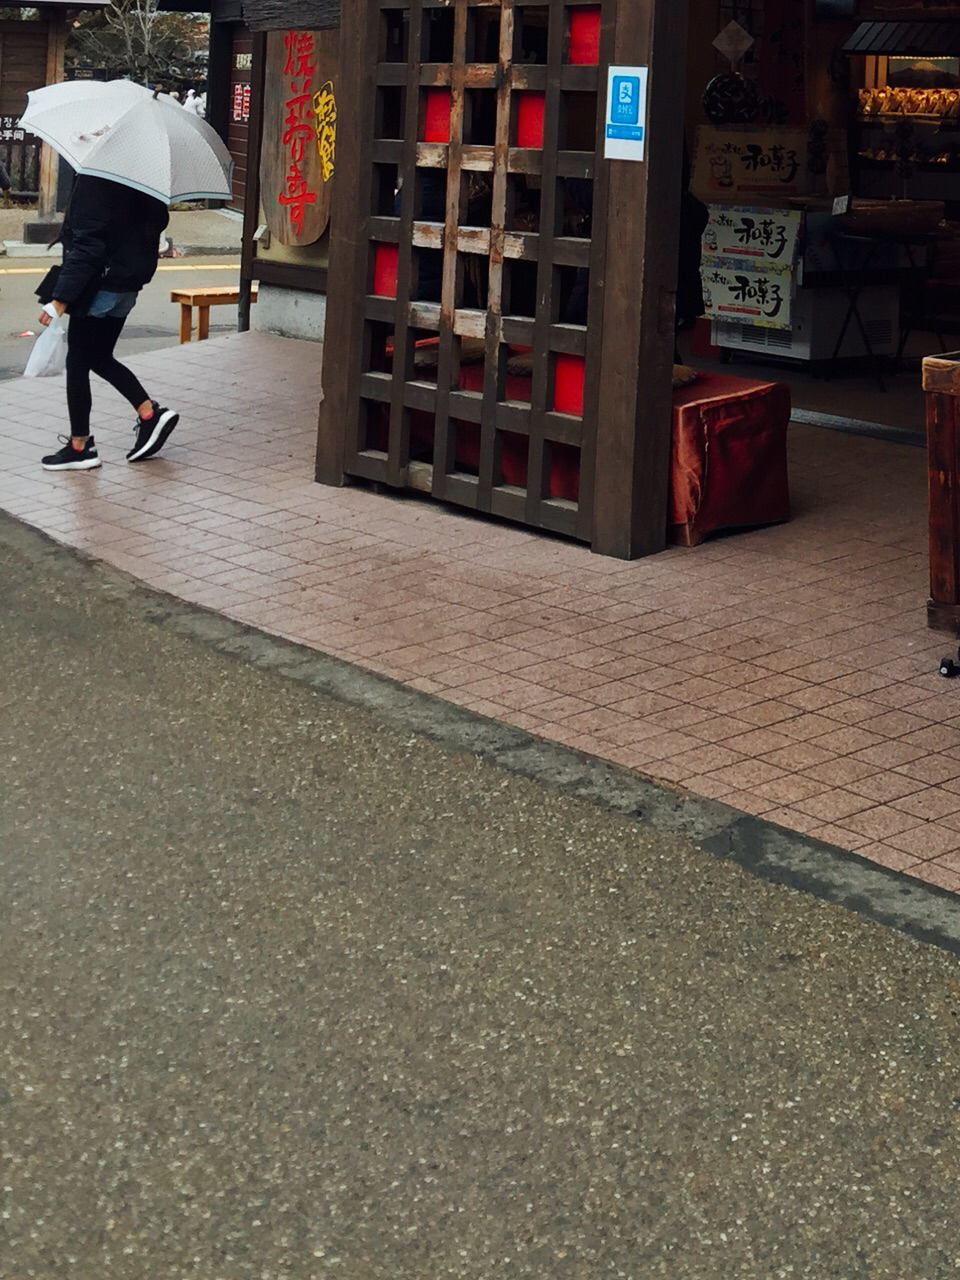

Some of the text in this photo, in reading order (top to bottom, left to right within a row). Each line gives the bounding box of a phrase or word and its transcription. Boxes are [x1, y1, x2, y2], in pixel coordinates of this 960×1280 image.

[741, 145, 800, 182] 和菓子
[733, 218, 788, 258] 和菓子
[729, 276, 784, 317] 和菓子
